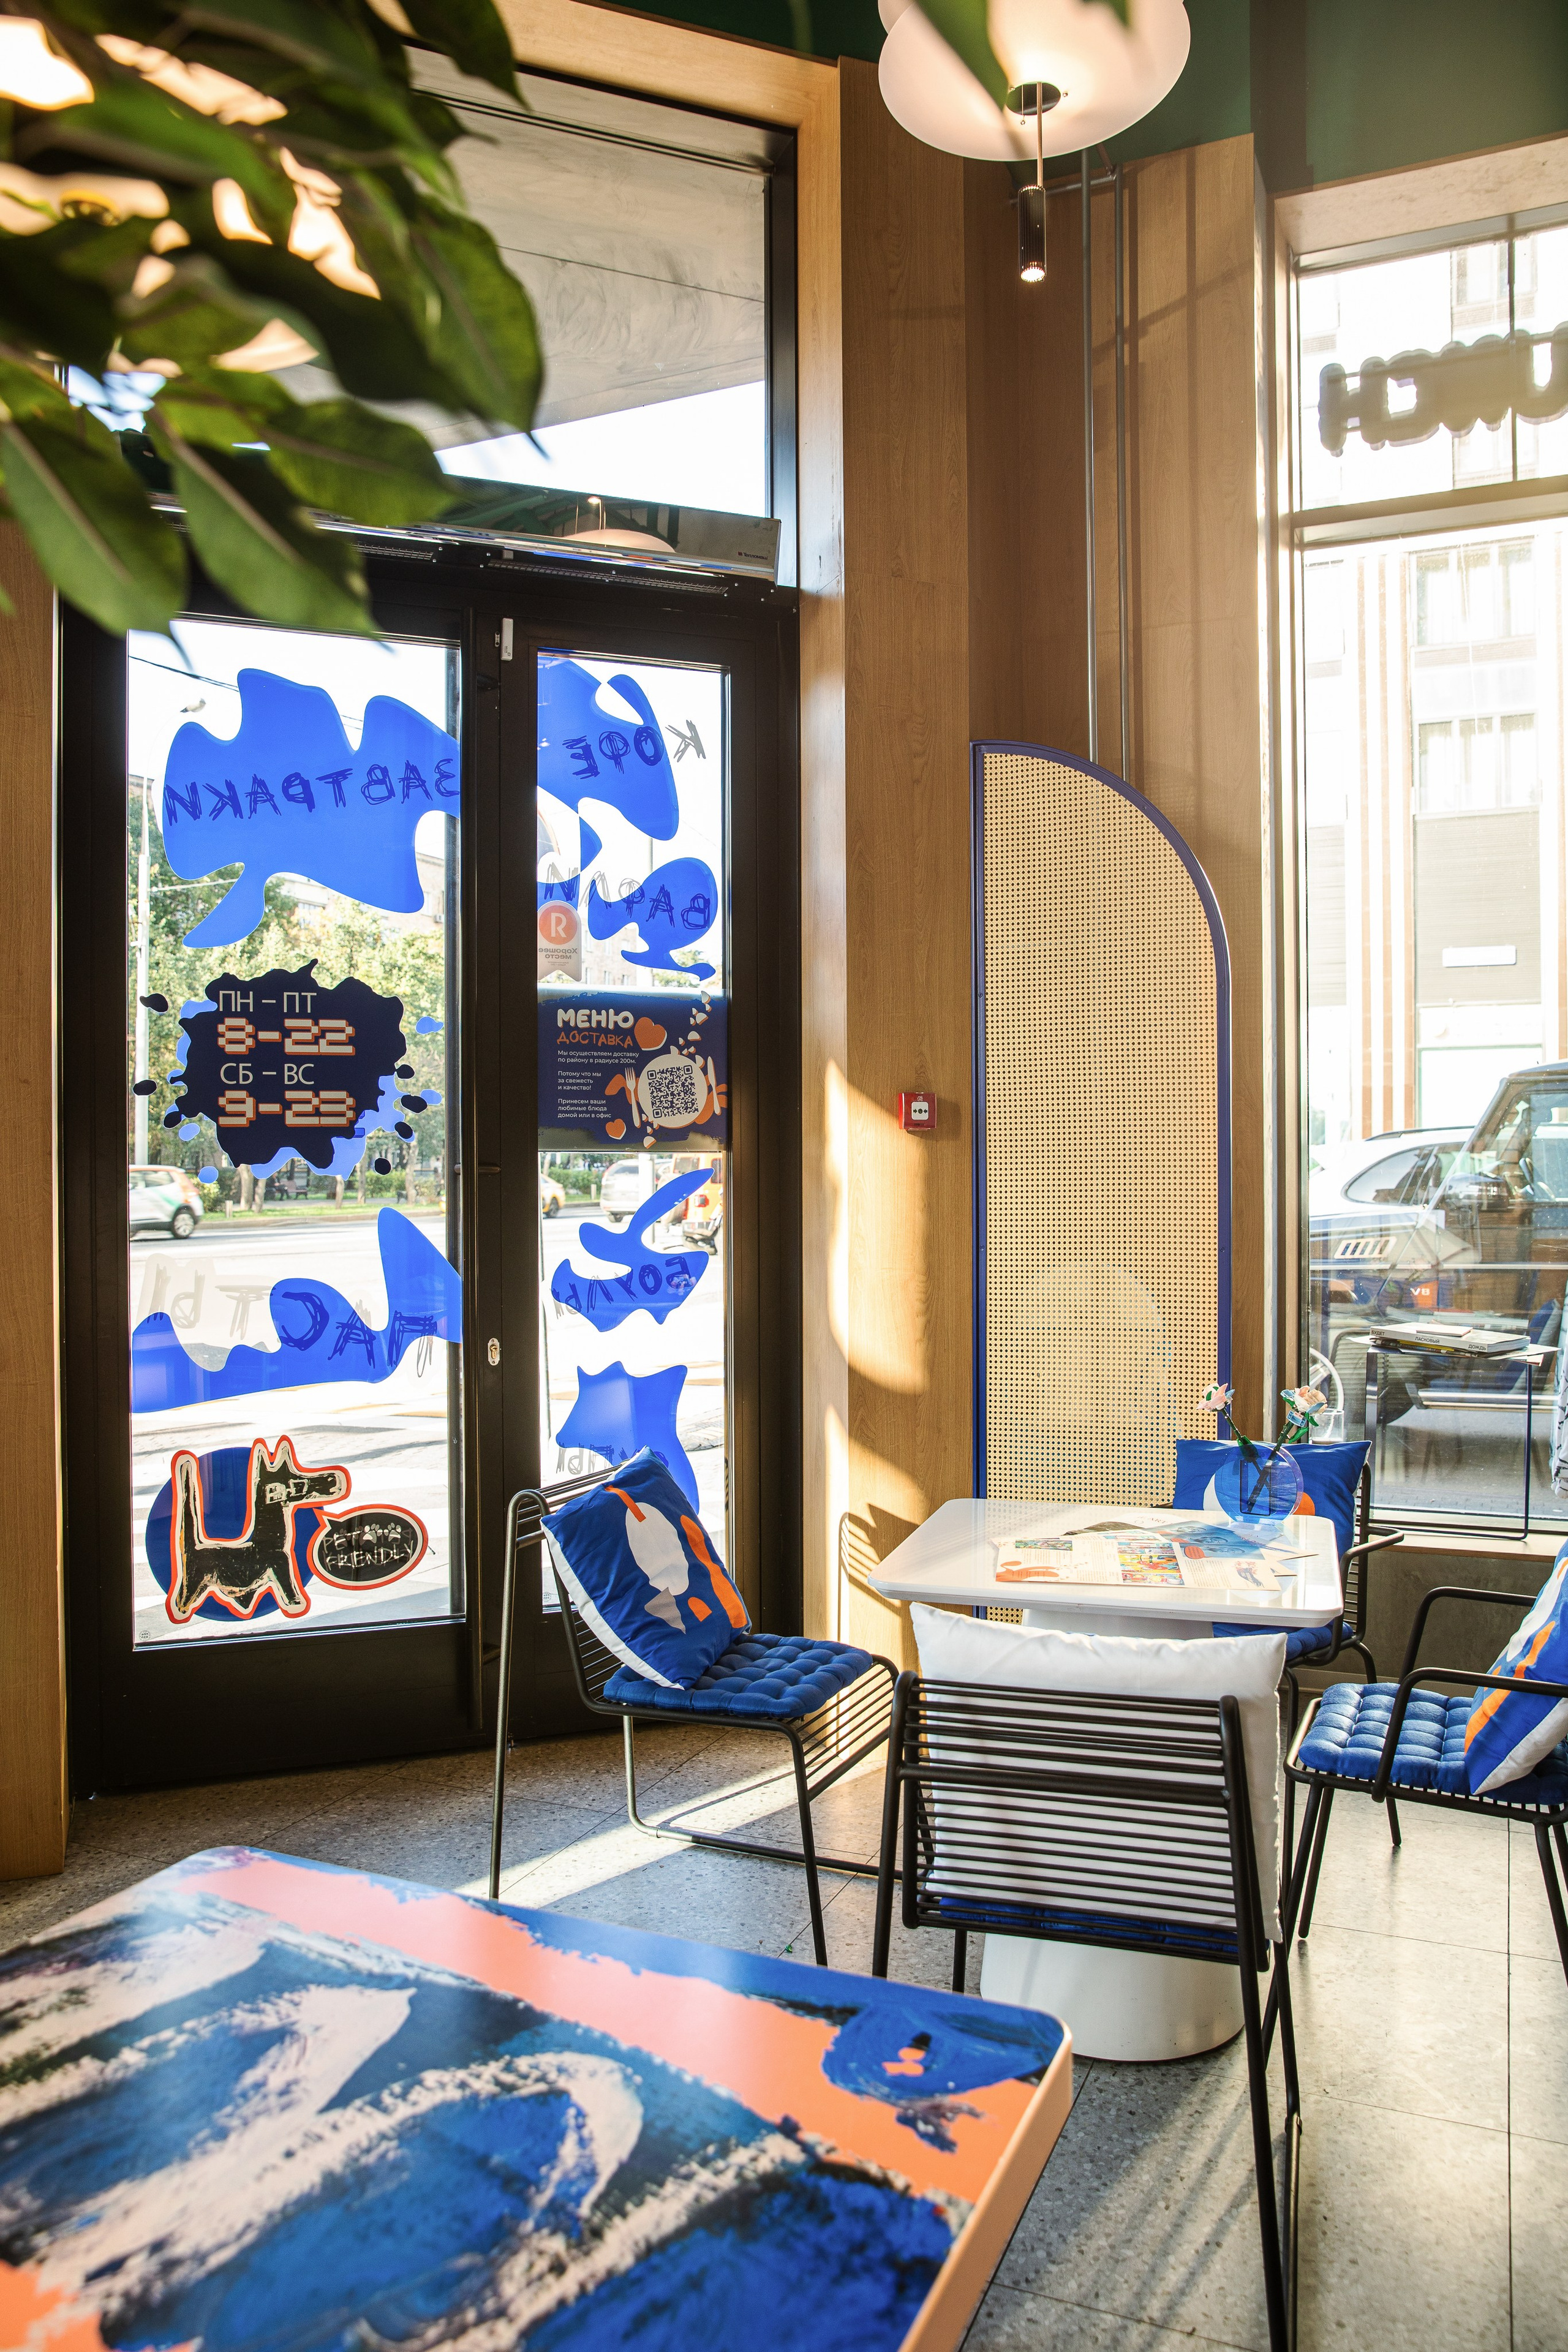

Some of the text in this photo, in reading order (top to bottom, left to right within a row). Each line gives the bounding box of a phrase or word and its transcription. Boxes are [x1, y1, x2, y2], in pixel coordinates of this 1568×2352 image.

[219, 990, 253, 1012] ПН
[284, 992, 317, 1013] ПТ
[557, 1008, 635, 1030] МЕНЮ
[557, 1030, 633, 1049] ДОСТАВКА
[220, 1063, 254, 1085] СБ
[284, 1063, 315, 1085] ВС
[1410, 1287, 1430, 1296] V8
[322, 1530, 363, 1554] PET
[326, 1540, 413, 1571] FRIENDLY
